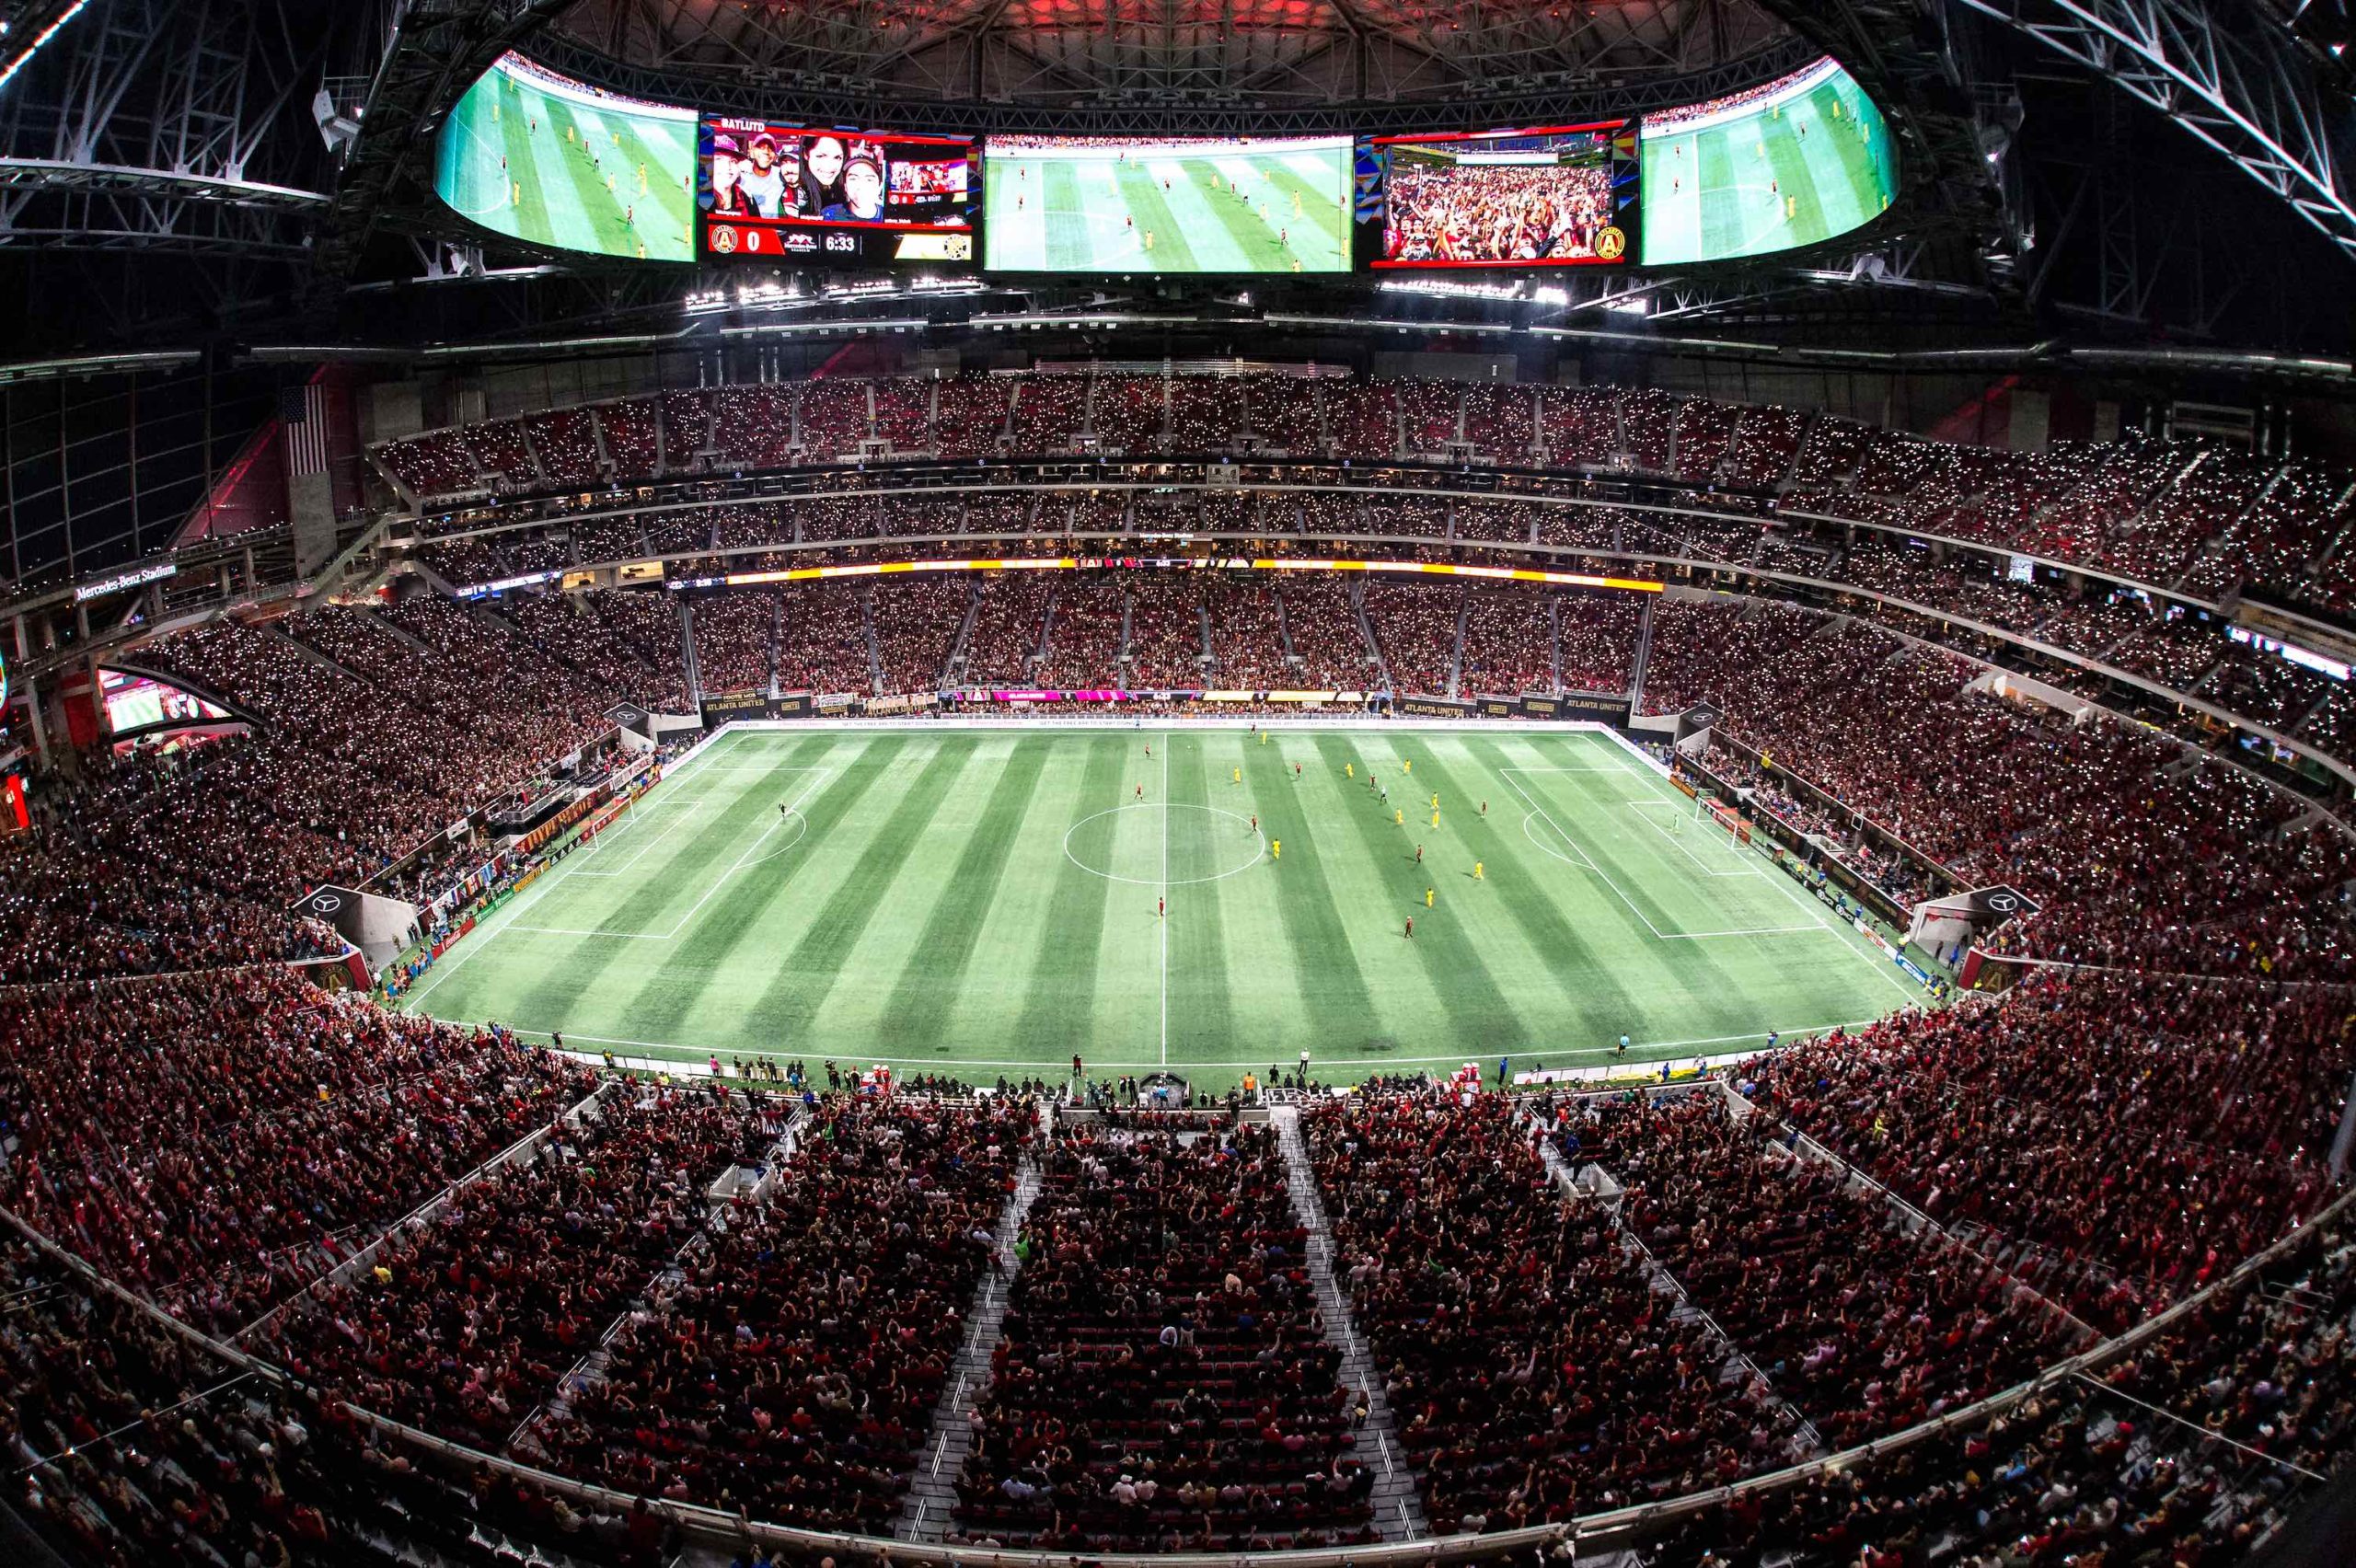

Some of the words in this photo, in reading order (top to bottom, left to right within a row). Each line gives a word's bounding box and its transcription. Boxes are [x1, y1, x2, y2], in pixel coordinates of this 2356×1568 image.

[722, 118, 765, 133] #ATLUTD
[747, 231, 760, 251] 0
[826, 236, 855, 252] 6:33
[75, 574, 141, 601] Mercedes-Benz
[141, 564, 177, 582] Stadium
[706, 700, 738, 711] ATLANTA
[738, 698, 765, 709] UNITED
[1404, 703, 1437, 714] ATLANTA
[1437, 707, 1465, 717] UNITED
[1566, 699, 1598, 709] ATLANTA
[1599, 703, 1626, 712] UNITED
